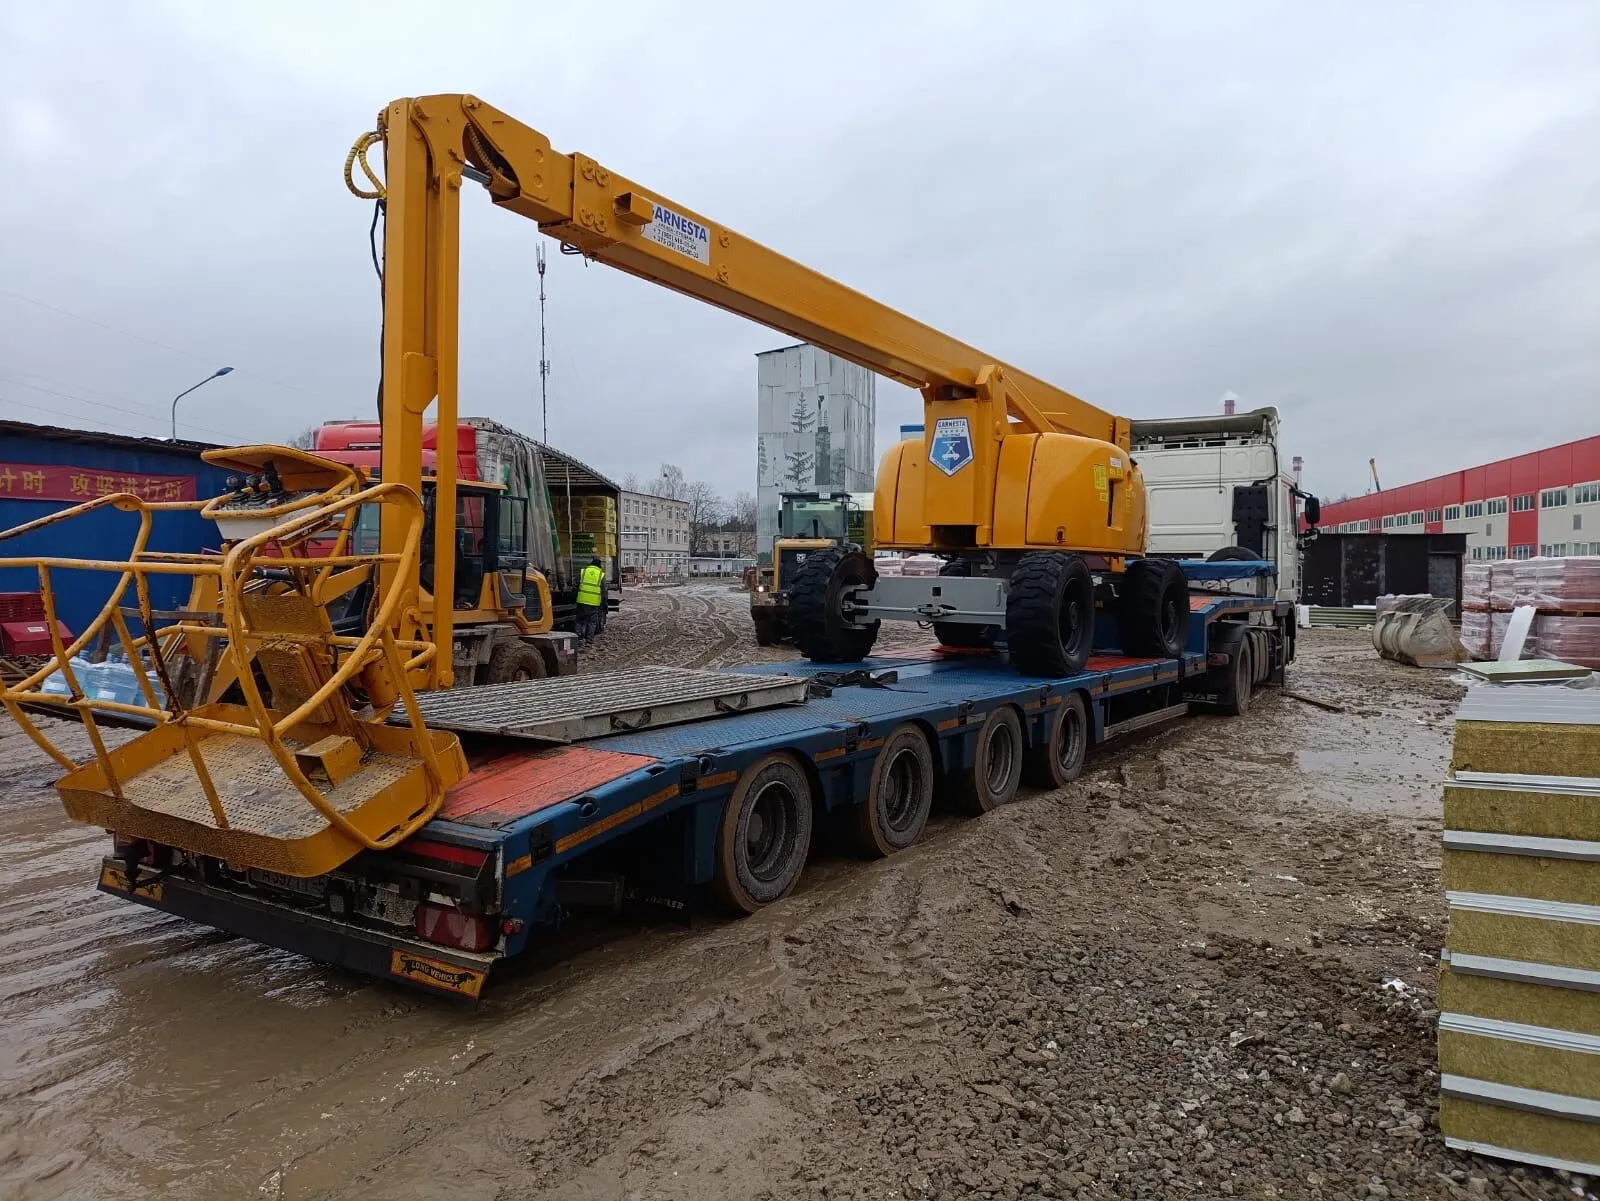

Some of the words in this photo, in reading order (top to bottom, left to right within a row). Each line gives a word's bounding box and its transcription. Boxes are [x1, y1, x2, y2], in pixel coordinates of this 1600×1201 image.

[653, 206, 708, 243] ARNESTA
[411, 960, 430, 974] LONG
[430, 968, 459, 983] VEHICLE
